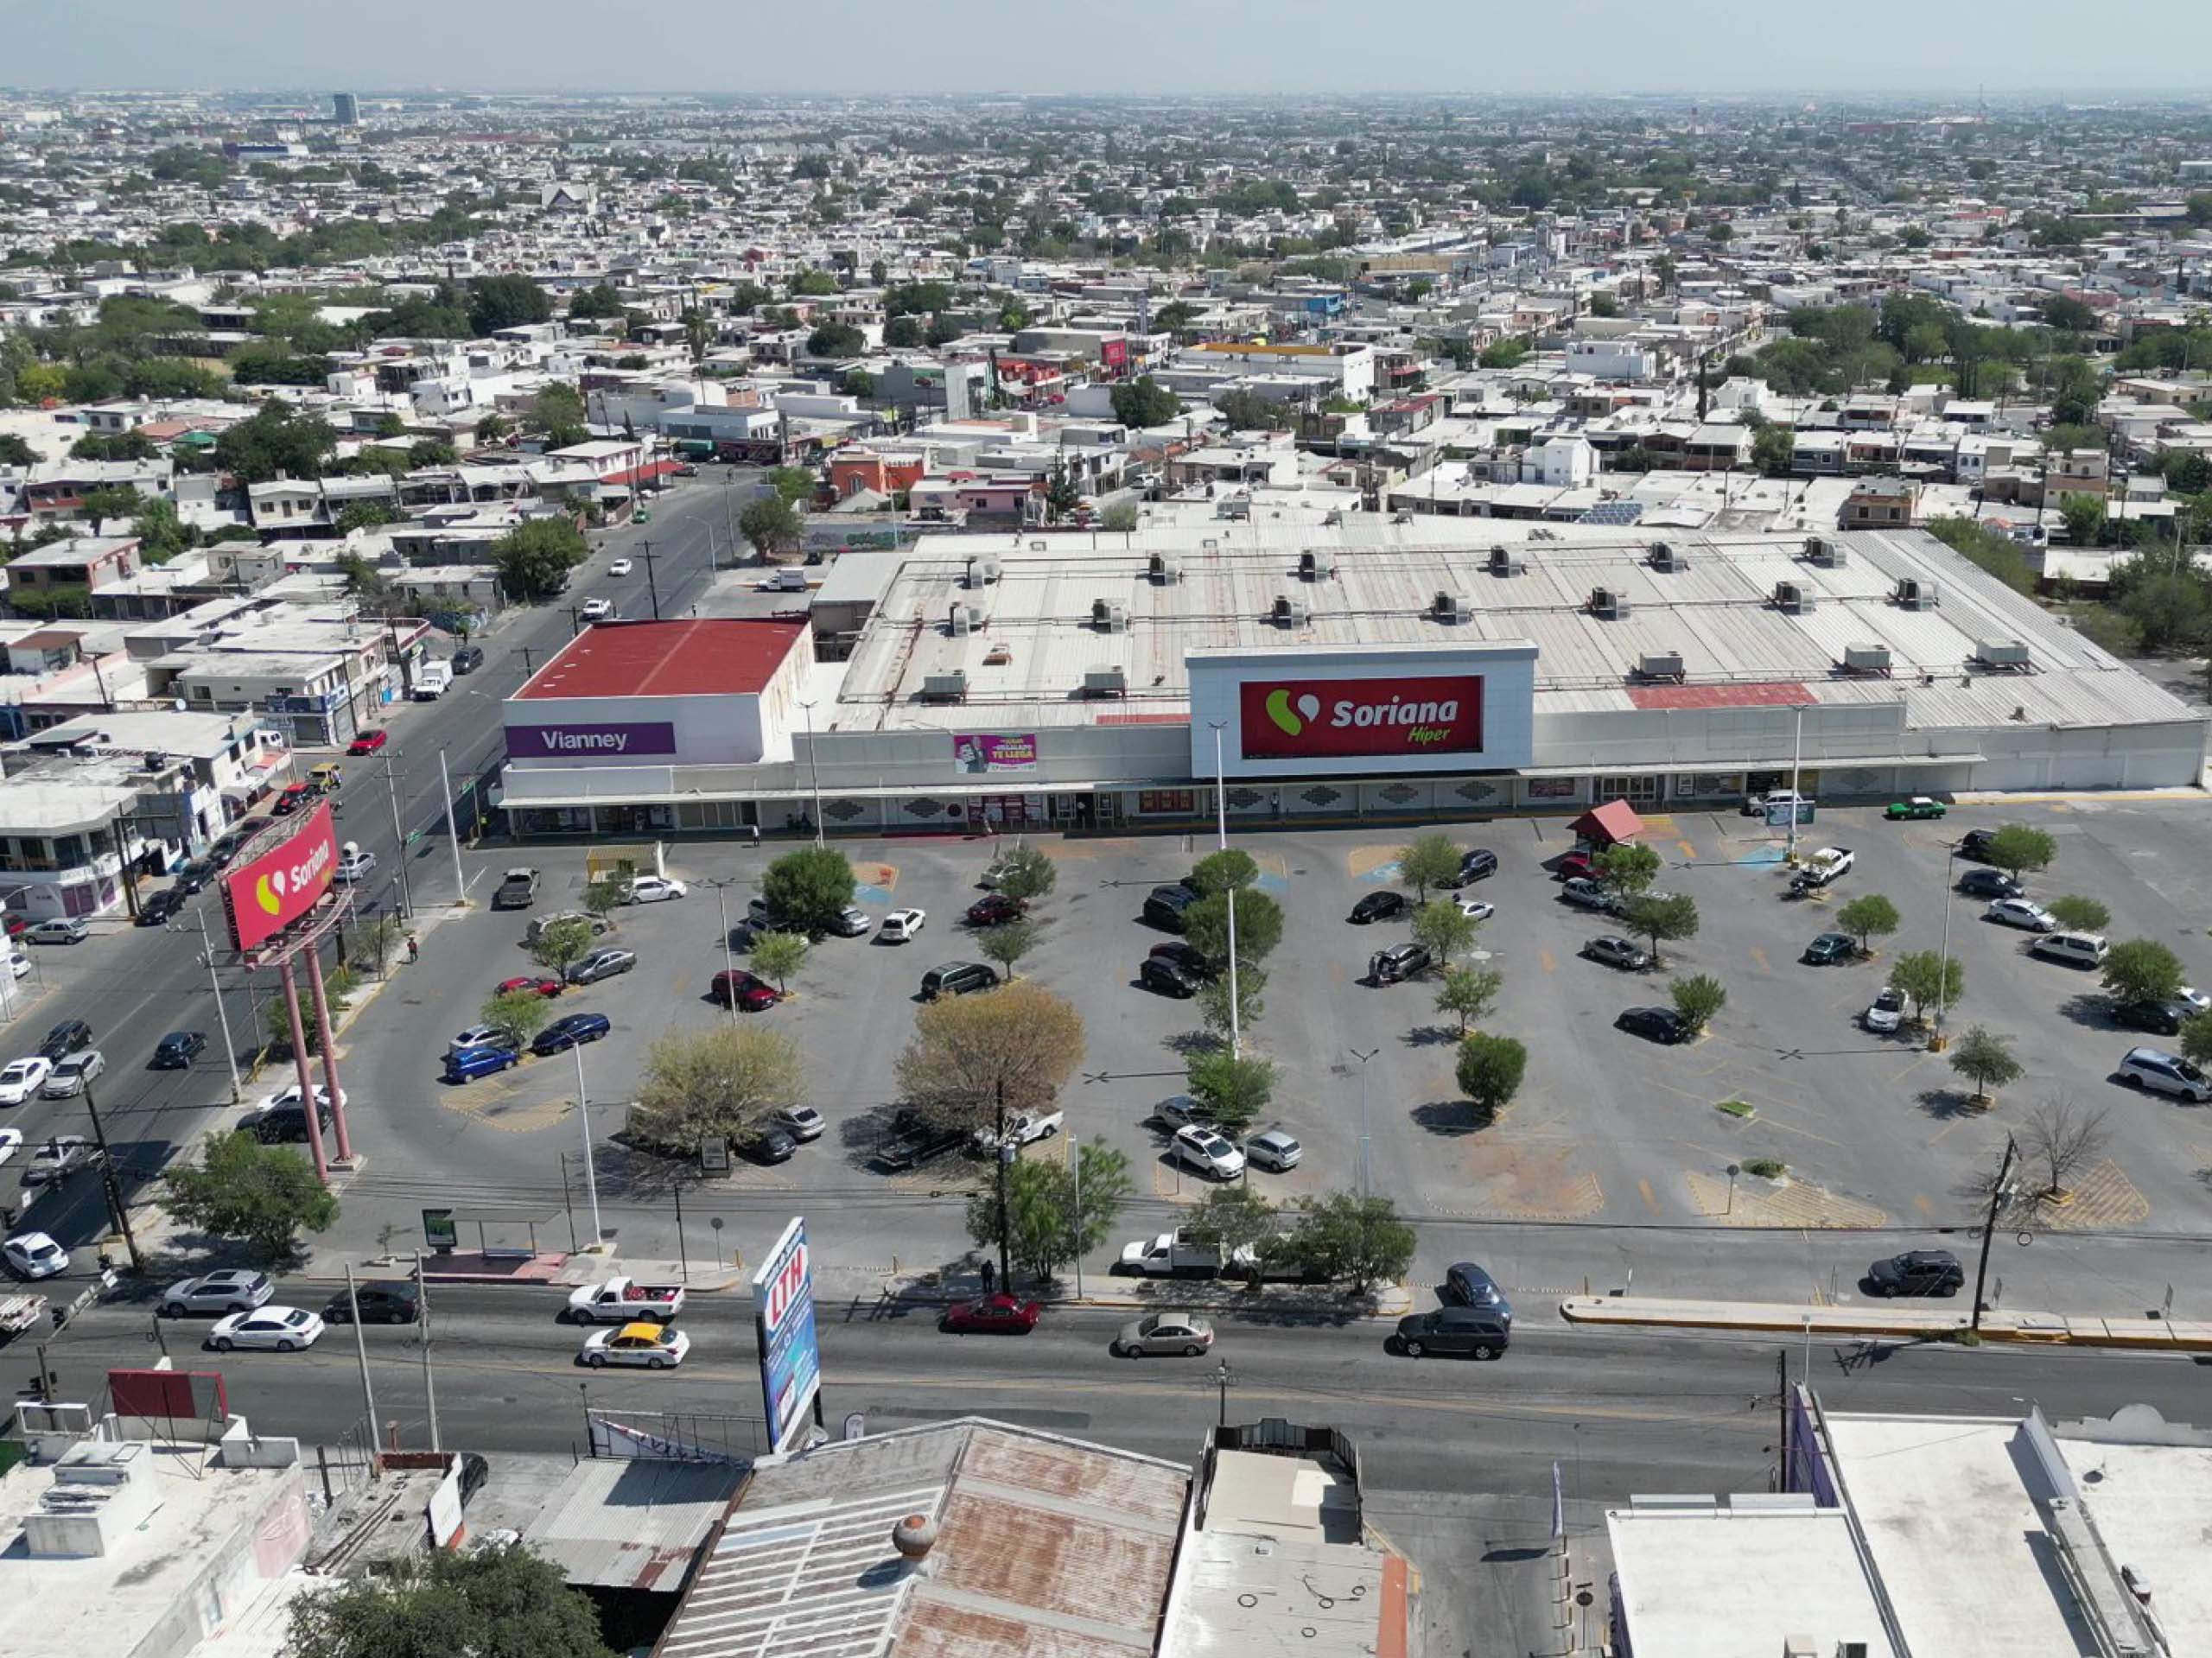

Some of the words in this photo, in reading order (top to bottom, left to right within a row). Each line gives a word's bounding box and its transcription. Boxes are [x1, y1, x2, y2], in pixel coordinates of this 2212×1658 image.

[1331, 695, 1459, 727] Soriana
[541, 730, 628, 751] Vianney
[291, 839, 329, 893] Soriana
[771, 1246, 802, 1327] LTH
